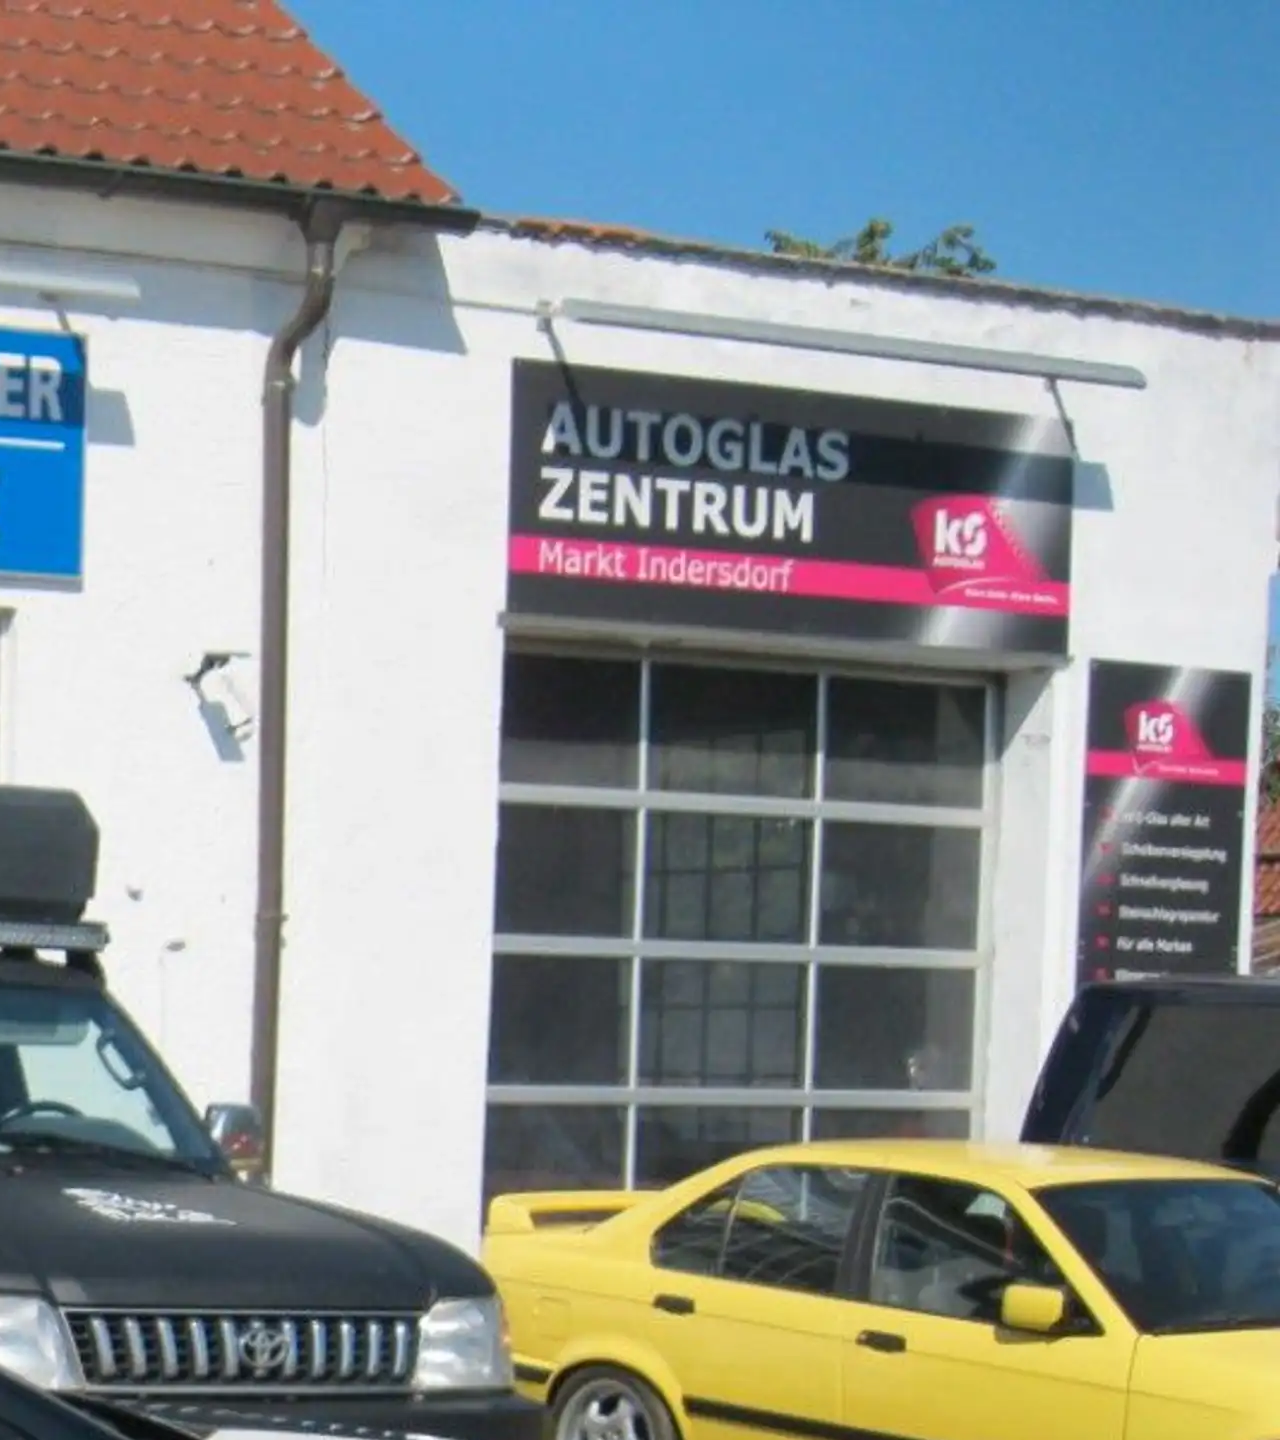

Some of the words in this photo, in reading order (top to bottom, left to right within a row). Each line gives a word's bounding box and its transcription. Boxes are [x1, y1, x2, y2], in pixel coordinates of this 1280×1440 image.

[541, 400, 851, 482] AUTOGLAS
[538, 467, 815, 543] ZENTRUM
[538, 541, 626, 579] Markt
[636, 553, 794, 593] Indersdorf
